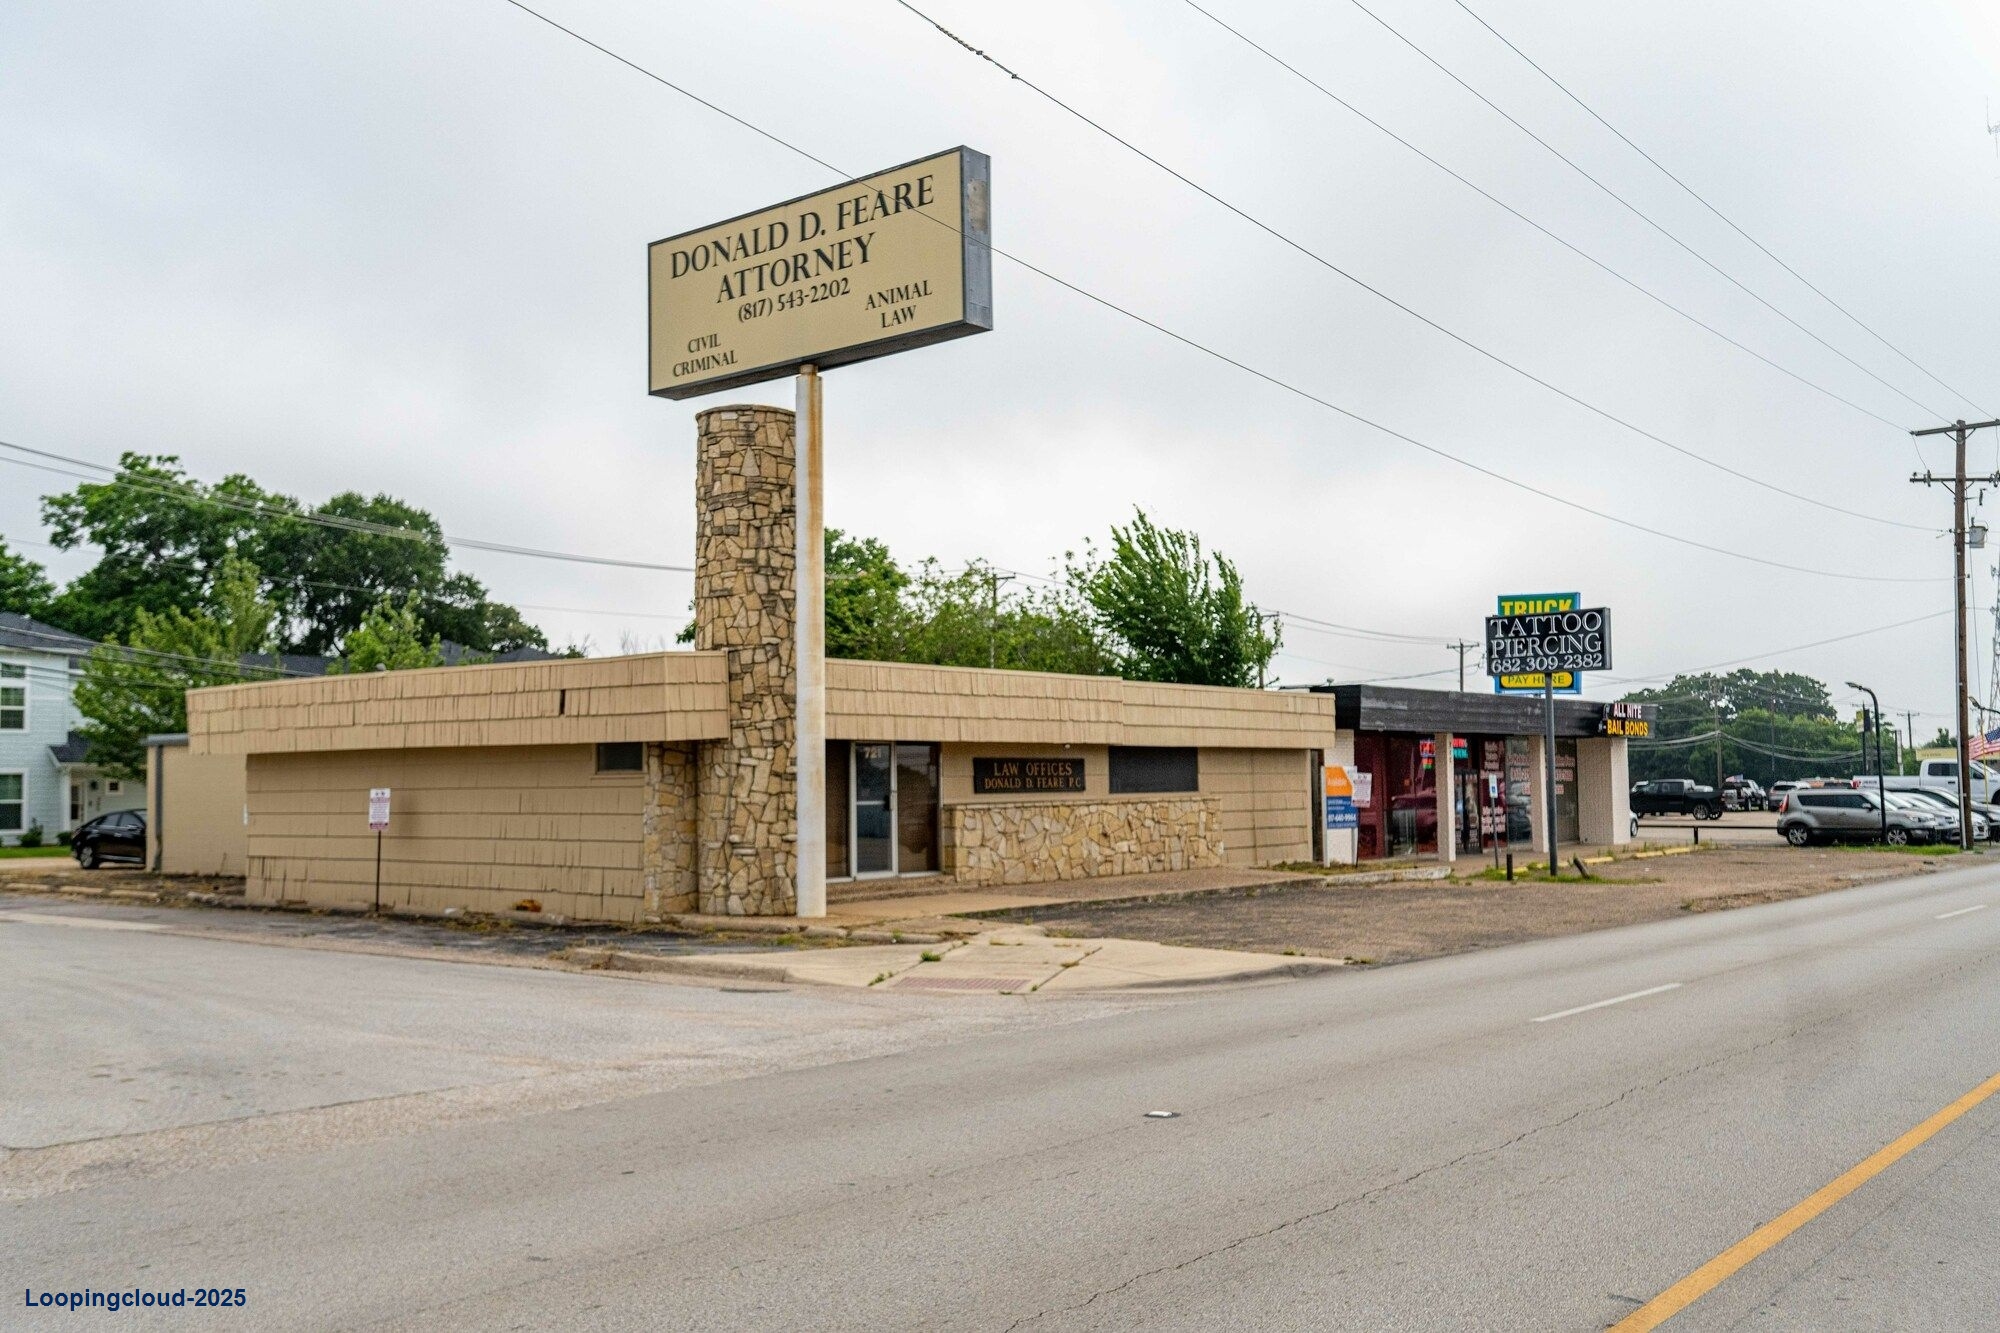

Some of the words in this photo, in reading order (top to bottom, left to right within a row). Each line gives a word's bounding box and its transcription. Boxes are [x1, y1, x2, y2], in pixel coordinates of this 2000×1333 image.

[670, 221, 790, 279] DONALD
[799, 212, 826, 243] D.
[836, 174, 935, 231] FEARE
[716, 232, 876, 303] ATTORNEY
[738, 296, 773, 323] (817)
[777, 277, 851, 312] 543-2202
[864, 280, 933, 311] ANIMAL
[880, 305, 917, 329] LAW
[687, 333, 722, 353] CIVIL
[673, 350, 739, 377] CRIMINAL
[1490, 611, 1602, 638] TATTOO
[1491, 633, 1602, 659] PIERCING
[1491, 653, 1603, 674] 682-309-2382
[1508, 675, 1528, 685] PAY
[1613, 702, 1626, 718] ALL
[1626, 703, 1642, 719] NITE
[1607, 719, 1624, 735] BAIL
[1625, 720, 1649, 737] BONDS
[994, 762, 1019, 776] LAW
[1026, 762, 1073, 776] OFFICES
[985, 777, 1021, 789] DONALD
[1037, 777, 1065, 788] FEARE
